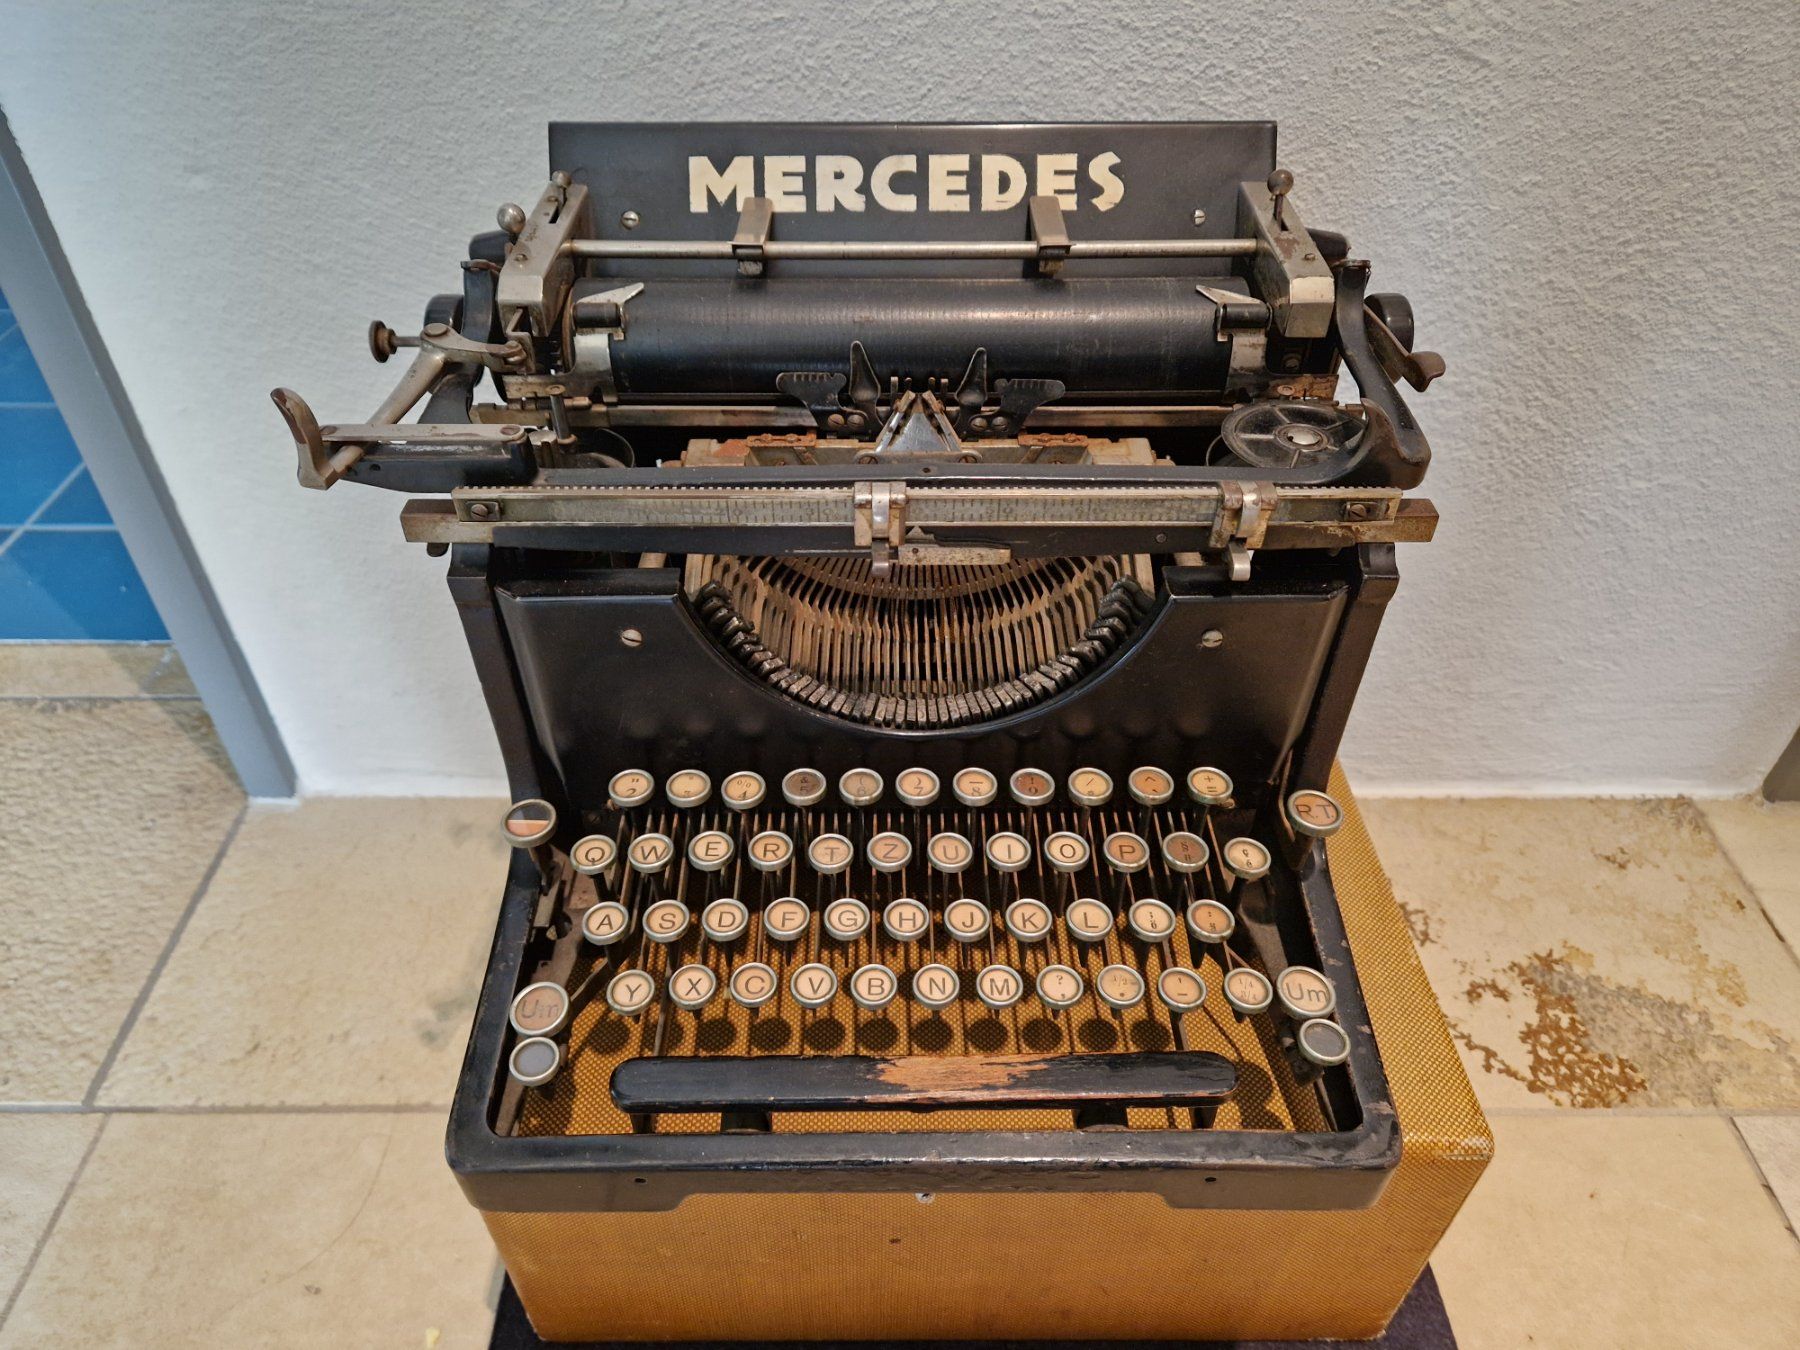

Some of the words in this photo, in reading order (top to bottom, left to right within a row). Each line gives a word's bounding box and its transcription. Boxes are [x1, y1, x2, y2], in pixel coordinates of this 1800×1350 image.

[688, 151, 1125, 213] MERCEDES
[584, 846, 605, 865] Q
[640, 845, 667, 861] W
[704, 841, 722, 857] E
[762, 843, 780, 859] R
[824, 847, 841, 862] T
[882, 843, 898, 860] Z
[942, 845, 959, 861] U
[1059, 843, 1076, 859] O
[1118, 844, 1135, 860] P
[595, 913, 613, 931] A
[658, 912, 677, 930] S
[717, 911, 736, 928] D
[781, 911, 798, 928] F
[837, 909, 858, 928] G
[898, 911, 916, 928] H
[961, 911, 974, 928] J
[1021, 911, 1039, 929] K
[1083, 911, 1099, 929] L
[685, 977, 703, 996] X
[744, 975, 765, 995] C
[808, 976, 824, 995] V
[867, 977, 885, 996] B
[929, 976, 946, 996] N
[989, 977, 1011, 996] M
[1055, 974, 1063, 985] ?
[625, 983, 642, 1002] Y
[1285, 982, 1327, 1003] Um
